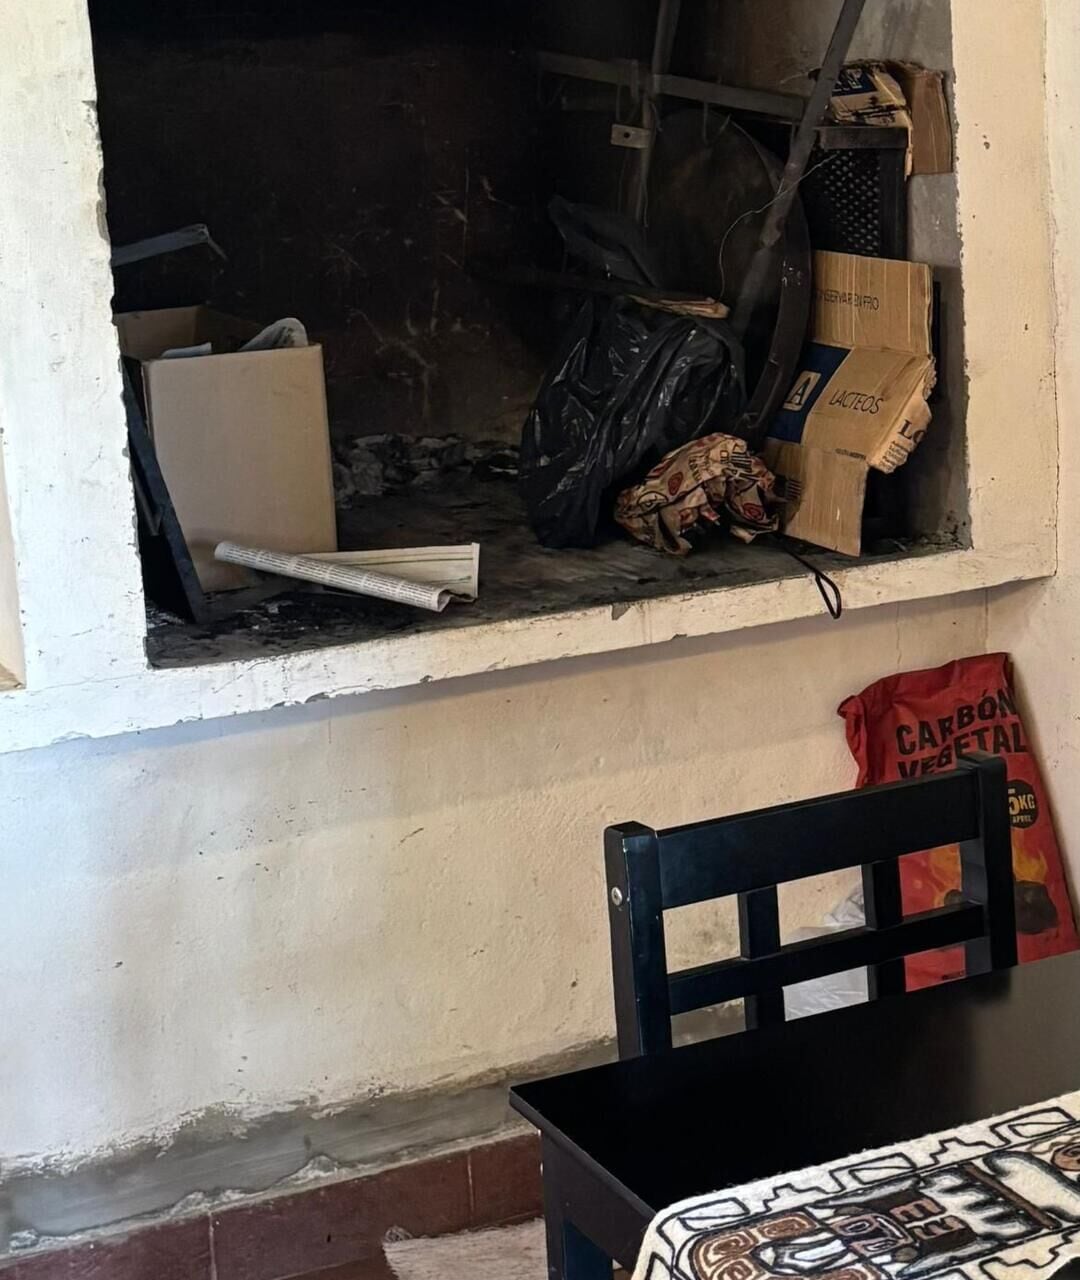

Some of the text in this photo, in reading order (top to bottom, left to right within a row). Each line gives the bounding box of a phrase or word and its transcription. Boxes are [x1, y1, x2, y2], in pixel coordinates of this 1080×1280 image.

[828, 389, 884, 415] LACTEOS
[896, 688, 1017, 755] CARBÓN
[897, 722, 1029, 779] VEGETAL
